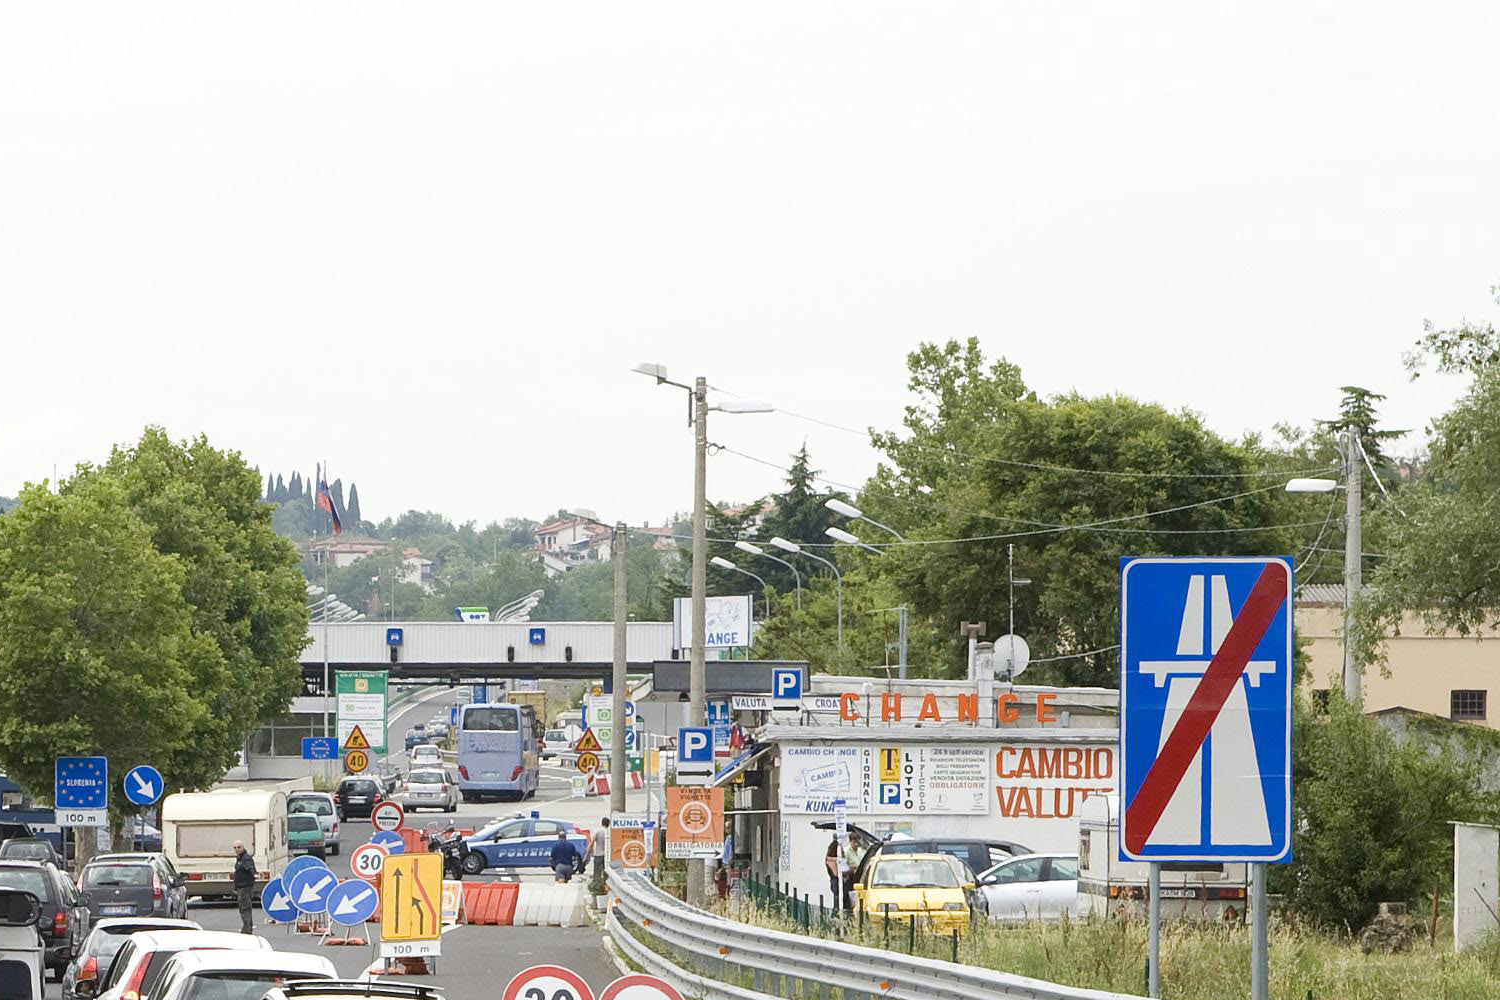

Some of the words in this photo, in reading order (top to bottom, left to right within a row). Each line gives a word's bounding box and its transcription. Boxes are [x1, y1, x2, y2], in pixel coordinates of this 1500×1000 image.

[707, 632, 738, 644] ANGE
[778, 673, 796, 696] P
[735, 698, 767, 707] VALUTA
[840, 692, 1057, 723] CHANGE
[684, 732, 708, 759] P
[350, 755, 364, 767] 40
[996, 747, 1113, 779] CAMBIO
[904, 753, 914, 809] LOTTO
[805, 800, 836, 812] KUNA
[996, 786, 1115, 818] VALUT
[66, 813, 84, 822] 100
[498, 847, 552, 858] POLIZIA
[360, 854, 382, 871] 30
[393, 945, 412, 954] 100
